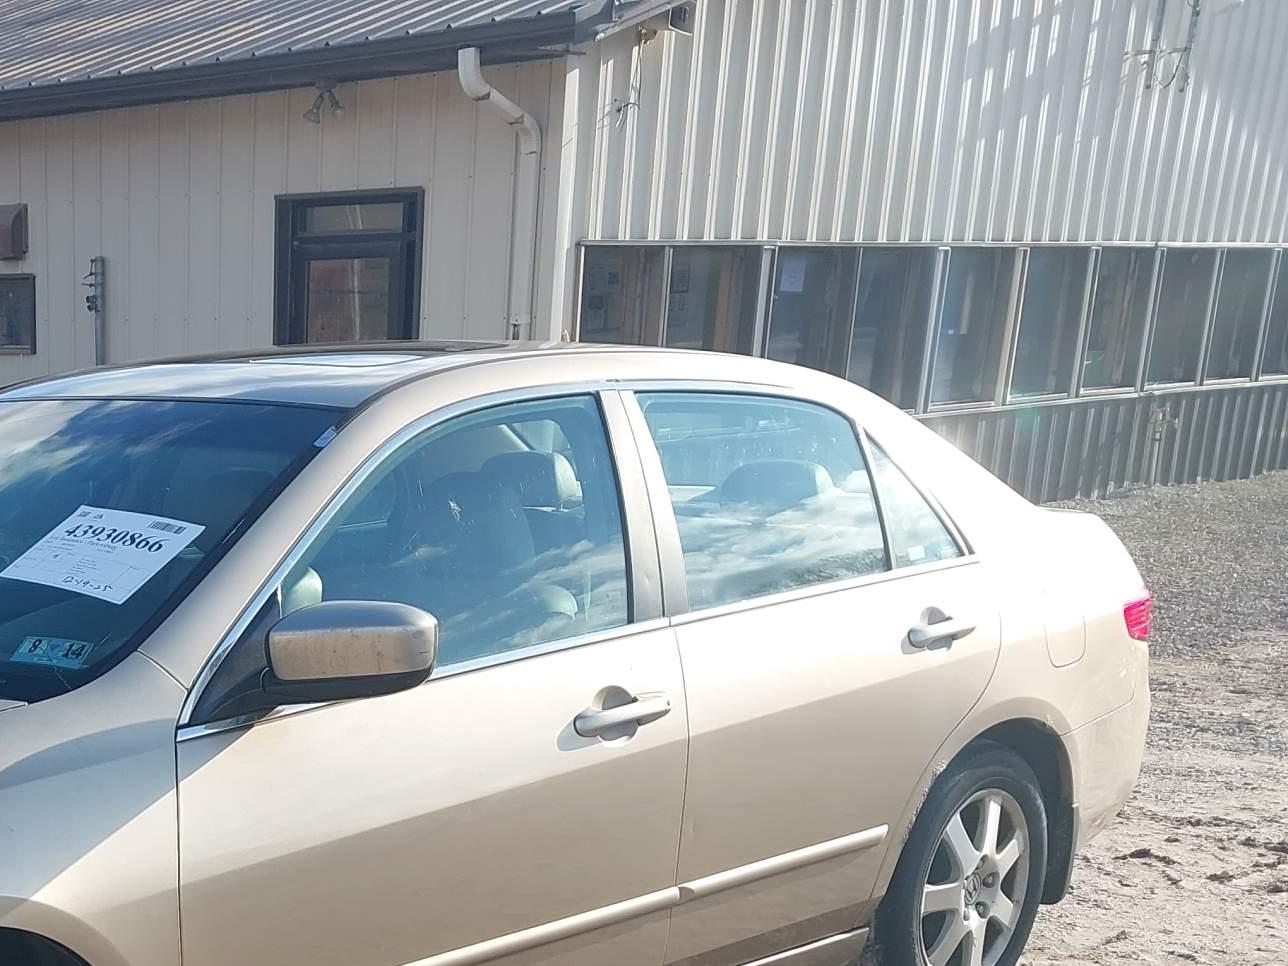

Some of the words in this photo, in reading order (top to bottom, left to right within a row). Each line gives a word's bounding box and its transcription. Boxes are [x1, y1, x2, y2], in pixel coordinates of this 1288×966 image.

[64, 523, 170, 553] 43930866
[28, 638, 42, 654] 8
[62, 643, 87, 659] 14
